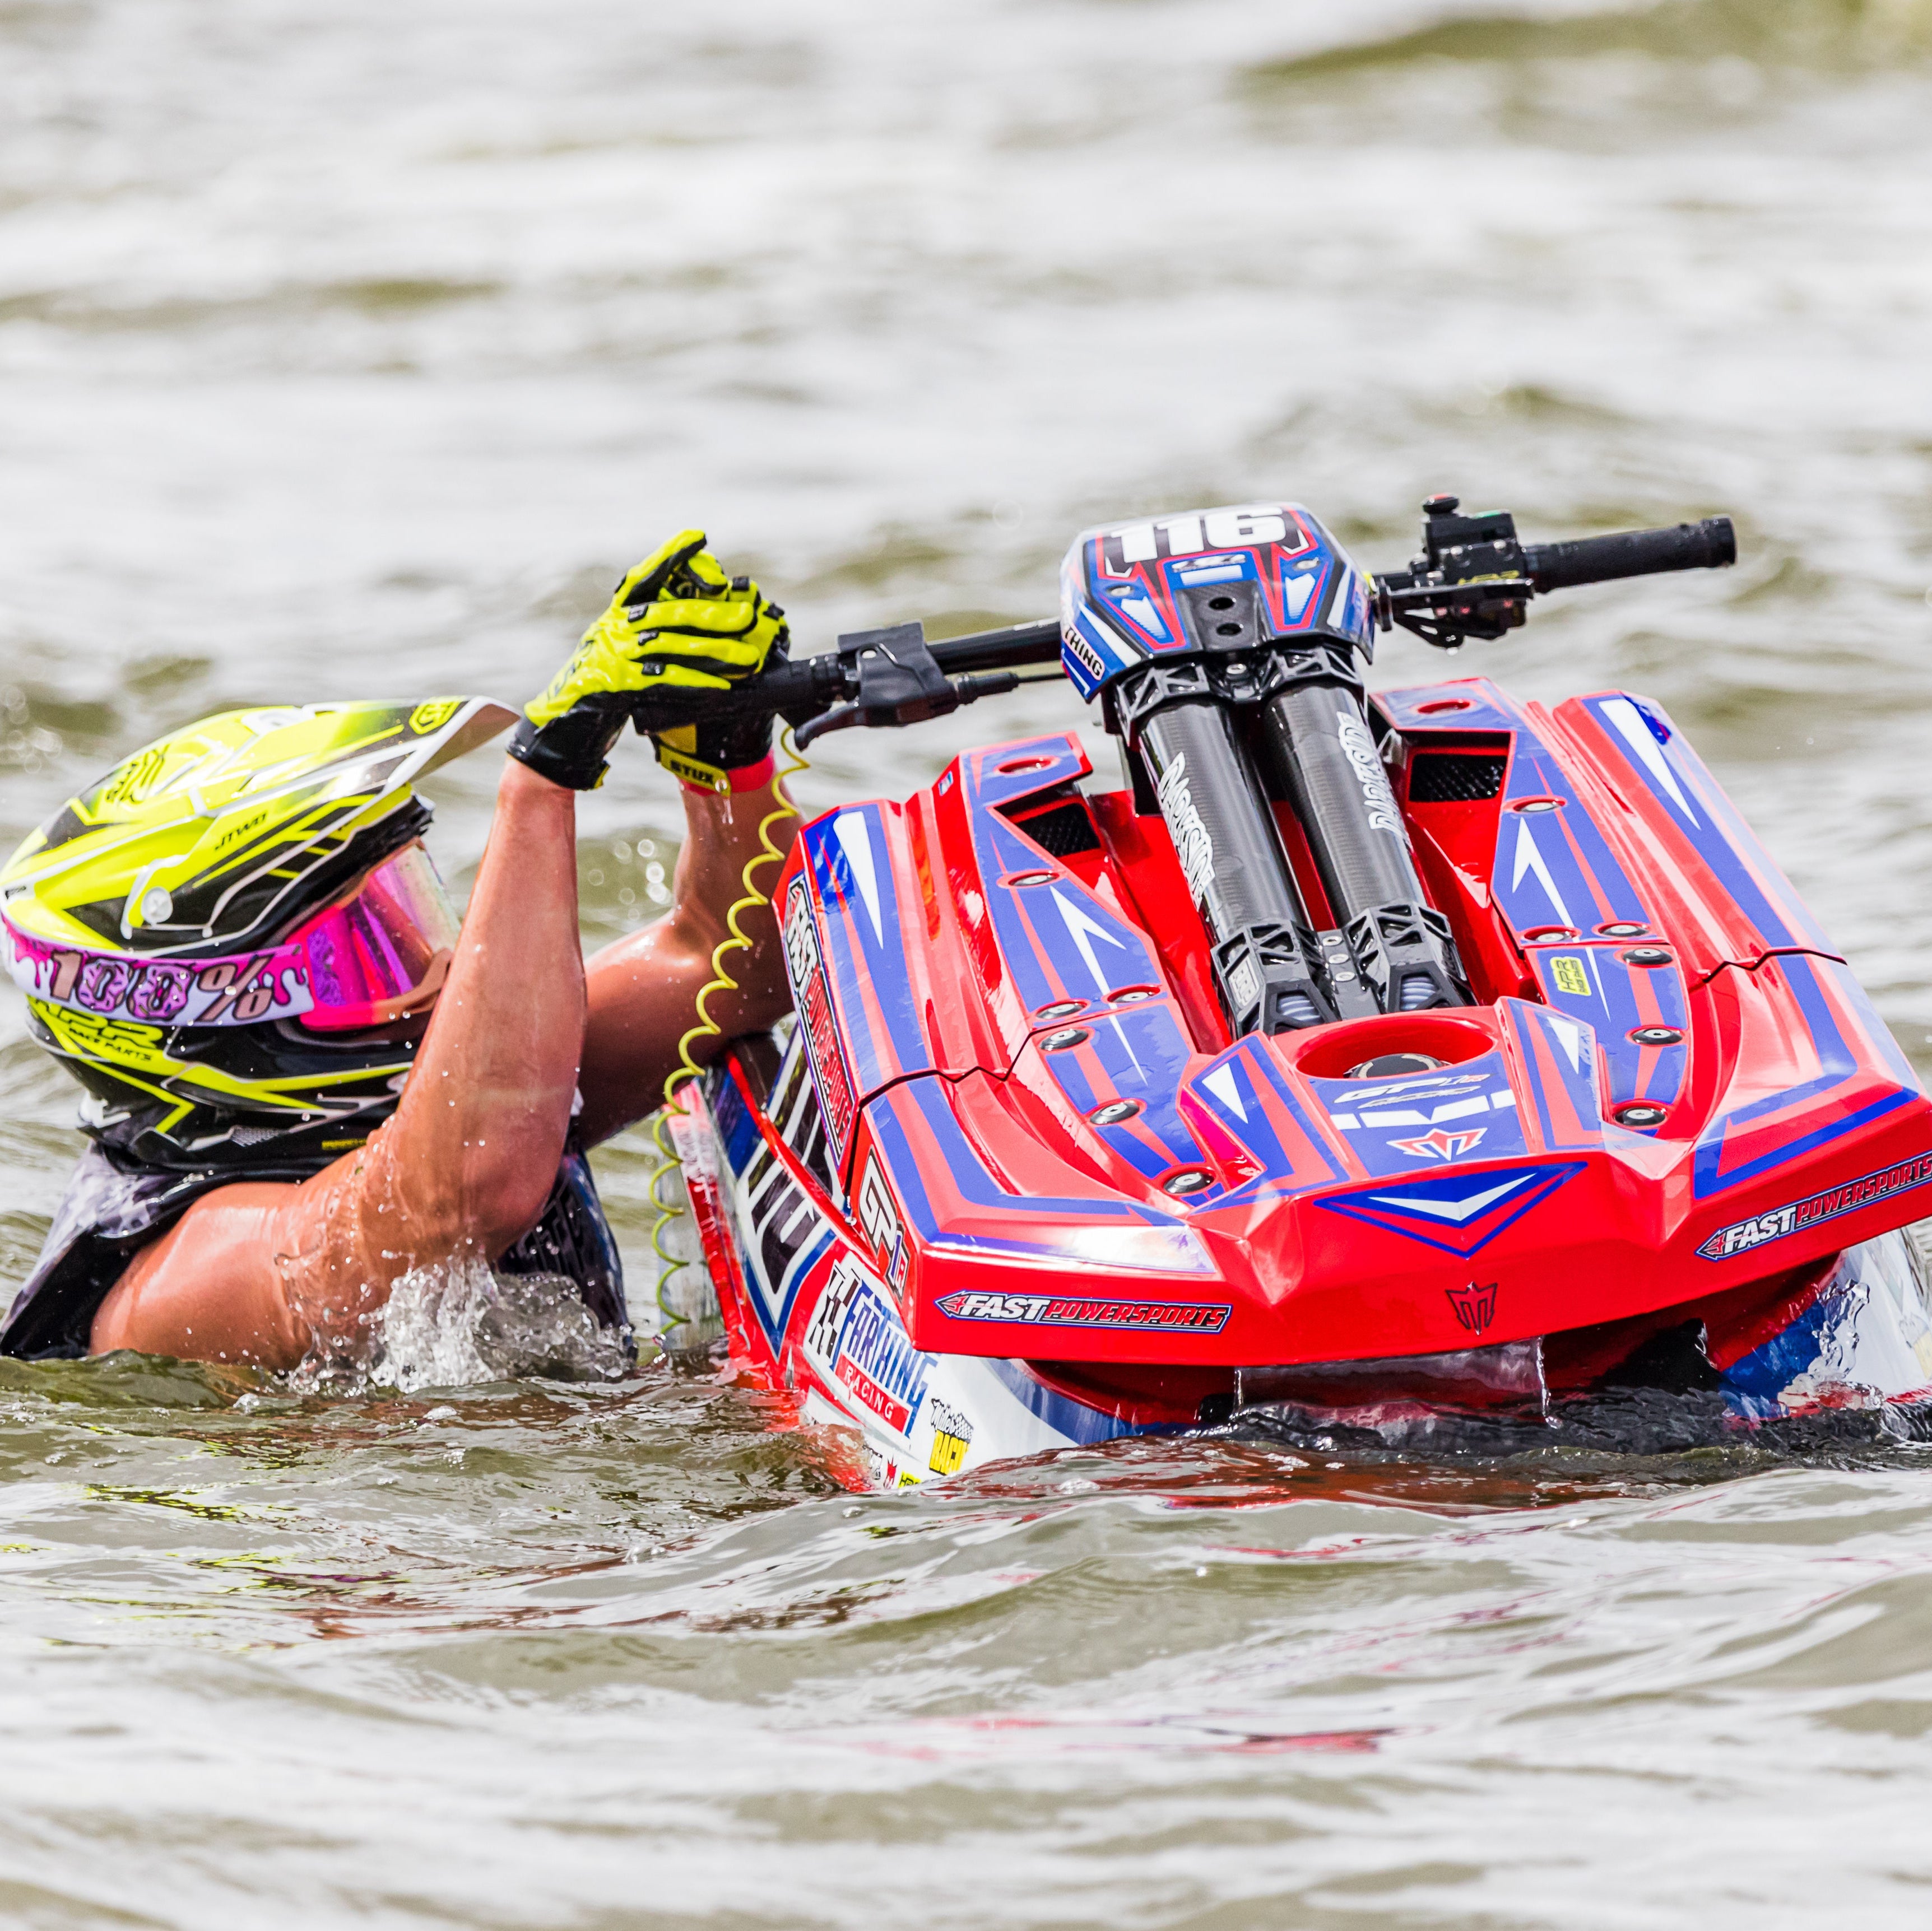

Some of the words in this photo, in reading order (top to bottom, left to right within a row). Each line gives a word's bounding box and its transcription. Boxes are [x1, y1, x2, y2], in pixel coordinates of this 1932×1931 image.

[1110, 506, 1287, 563] 116
[50, 950, 275, 1023] 100%
[1723, 1206, 1796, 1254] FAST
[1796, 1156, 1931, 1224] POWERSPORTS
[960, 1293, 1051, 1321] FAST
[1044, 1299, 1226, 1326] POWERSPORTS
[844, 1366, 894, 1420] RACING
